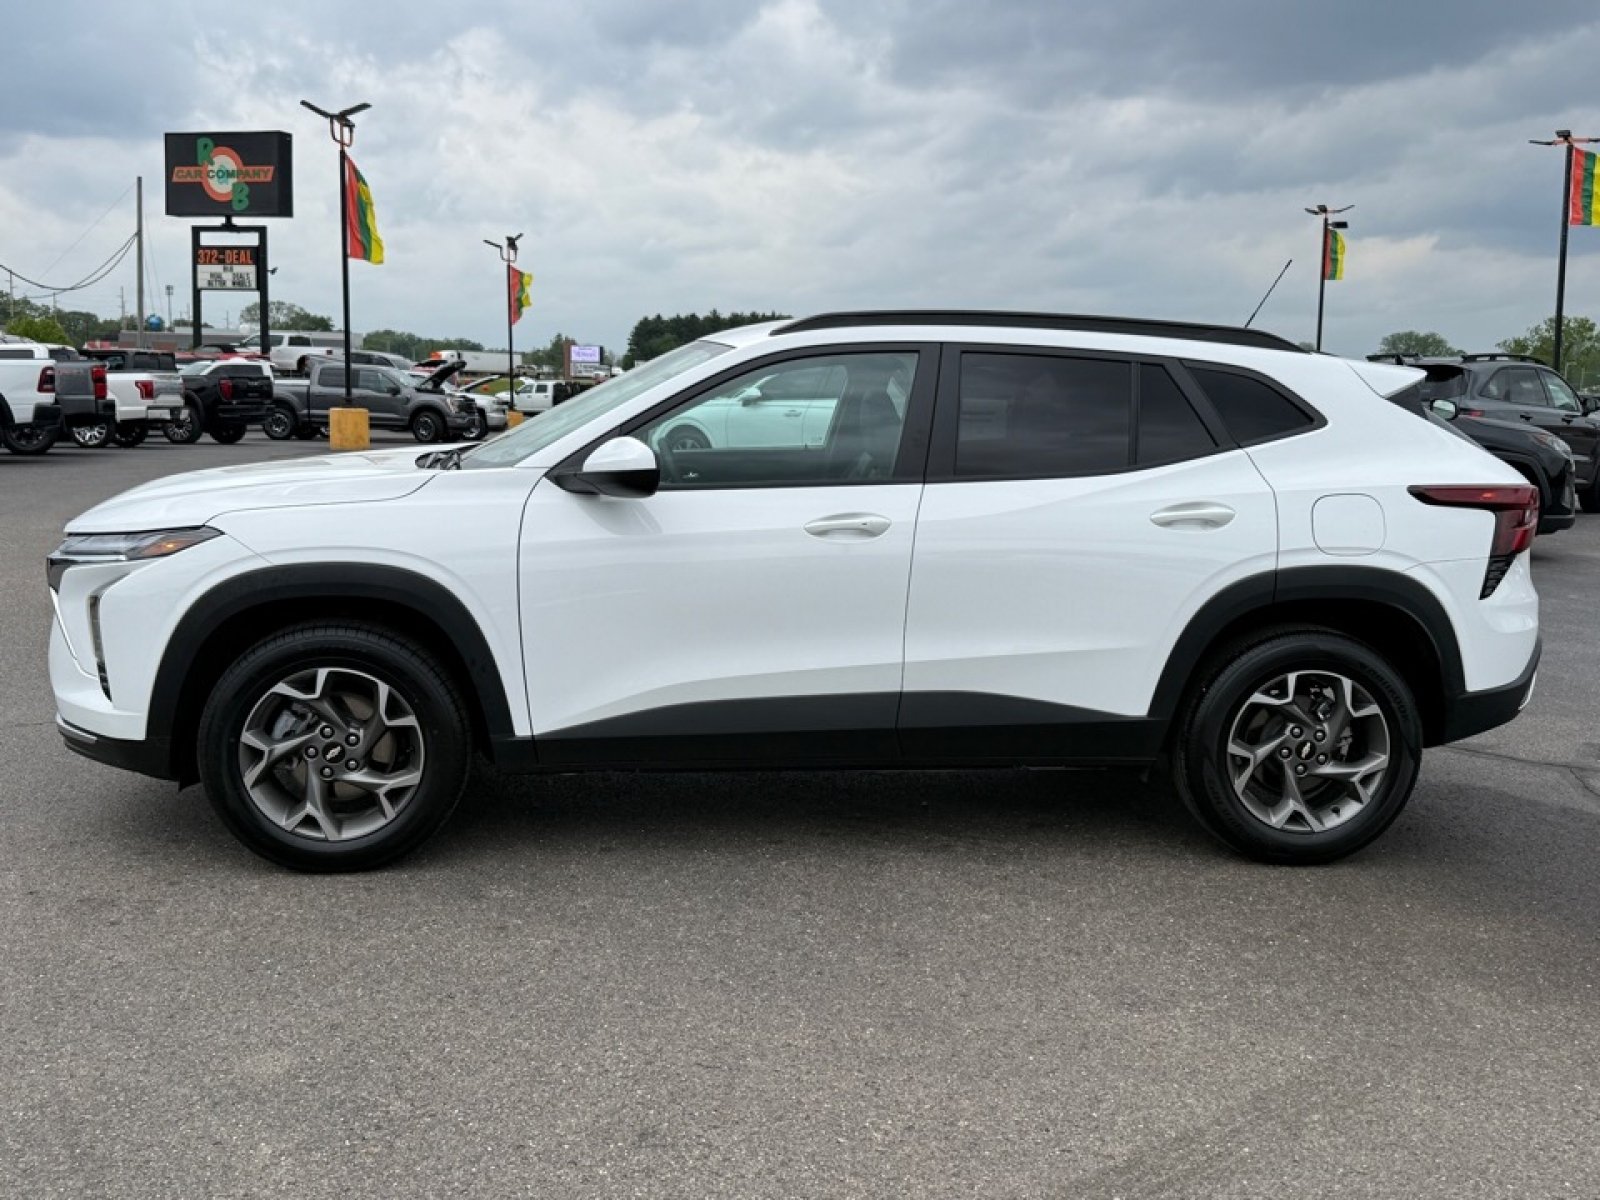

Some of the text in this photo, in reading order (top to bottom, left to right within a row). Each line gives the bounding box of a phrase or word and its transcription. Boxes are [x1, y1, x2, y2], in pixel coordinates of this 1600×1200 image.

[175, 169, 271, 180] CAR COMPANY
[198, 249, 253, 264] 372-DEAL
